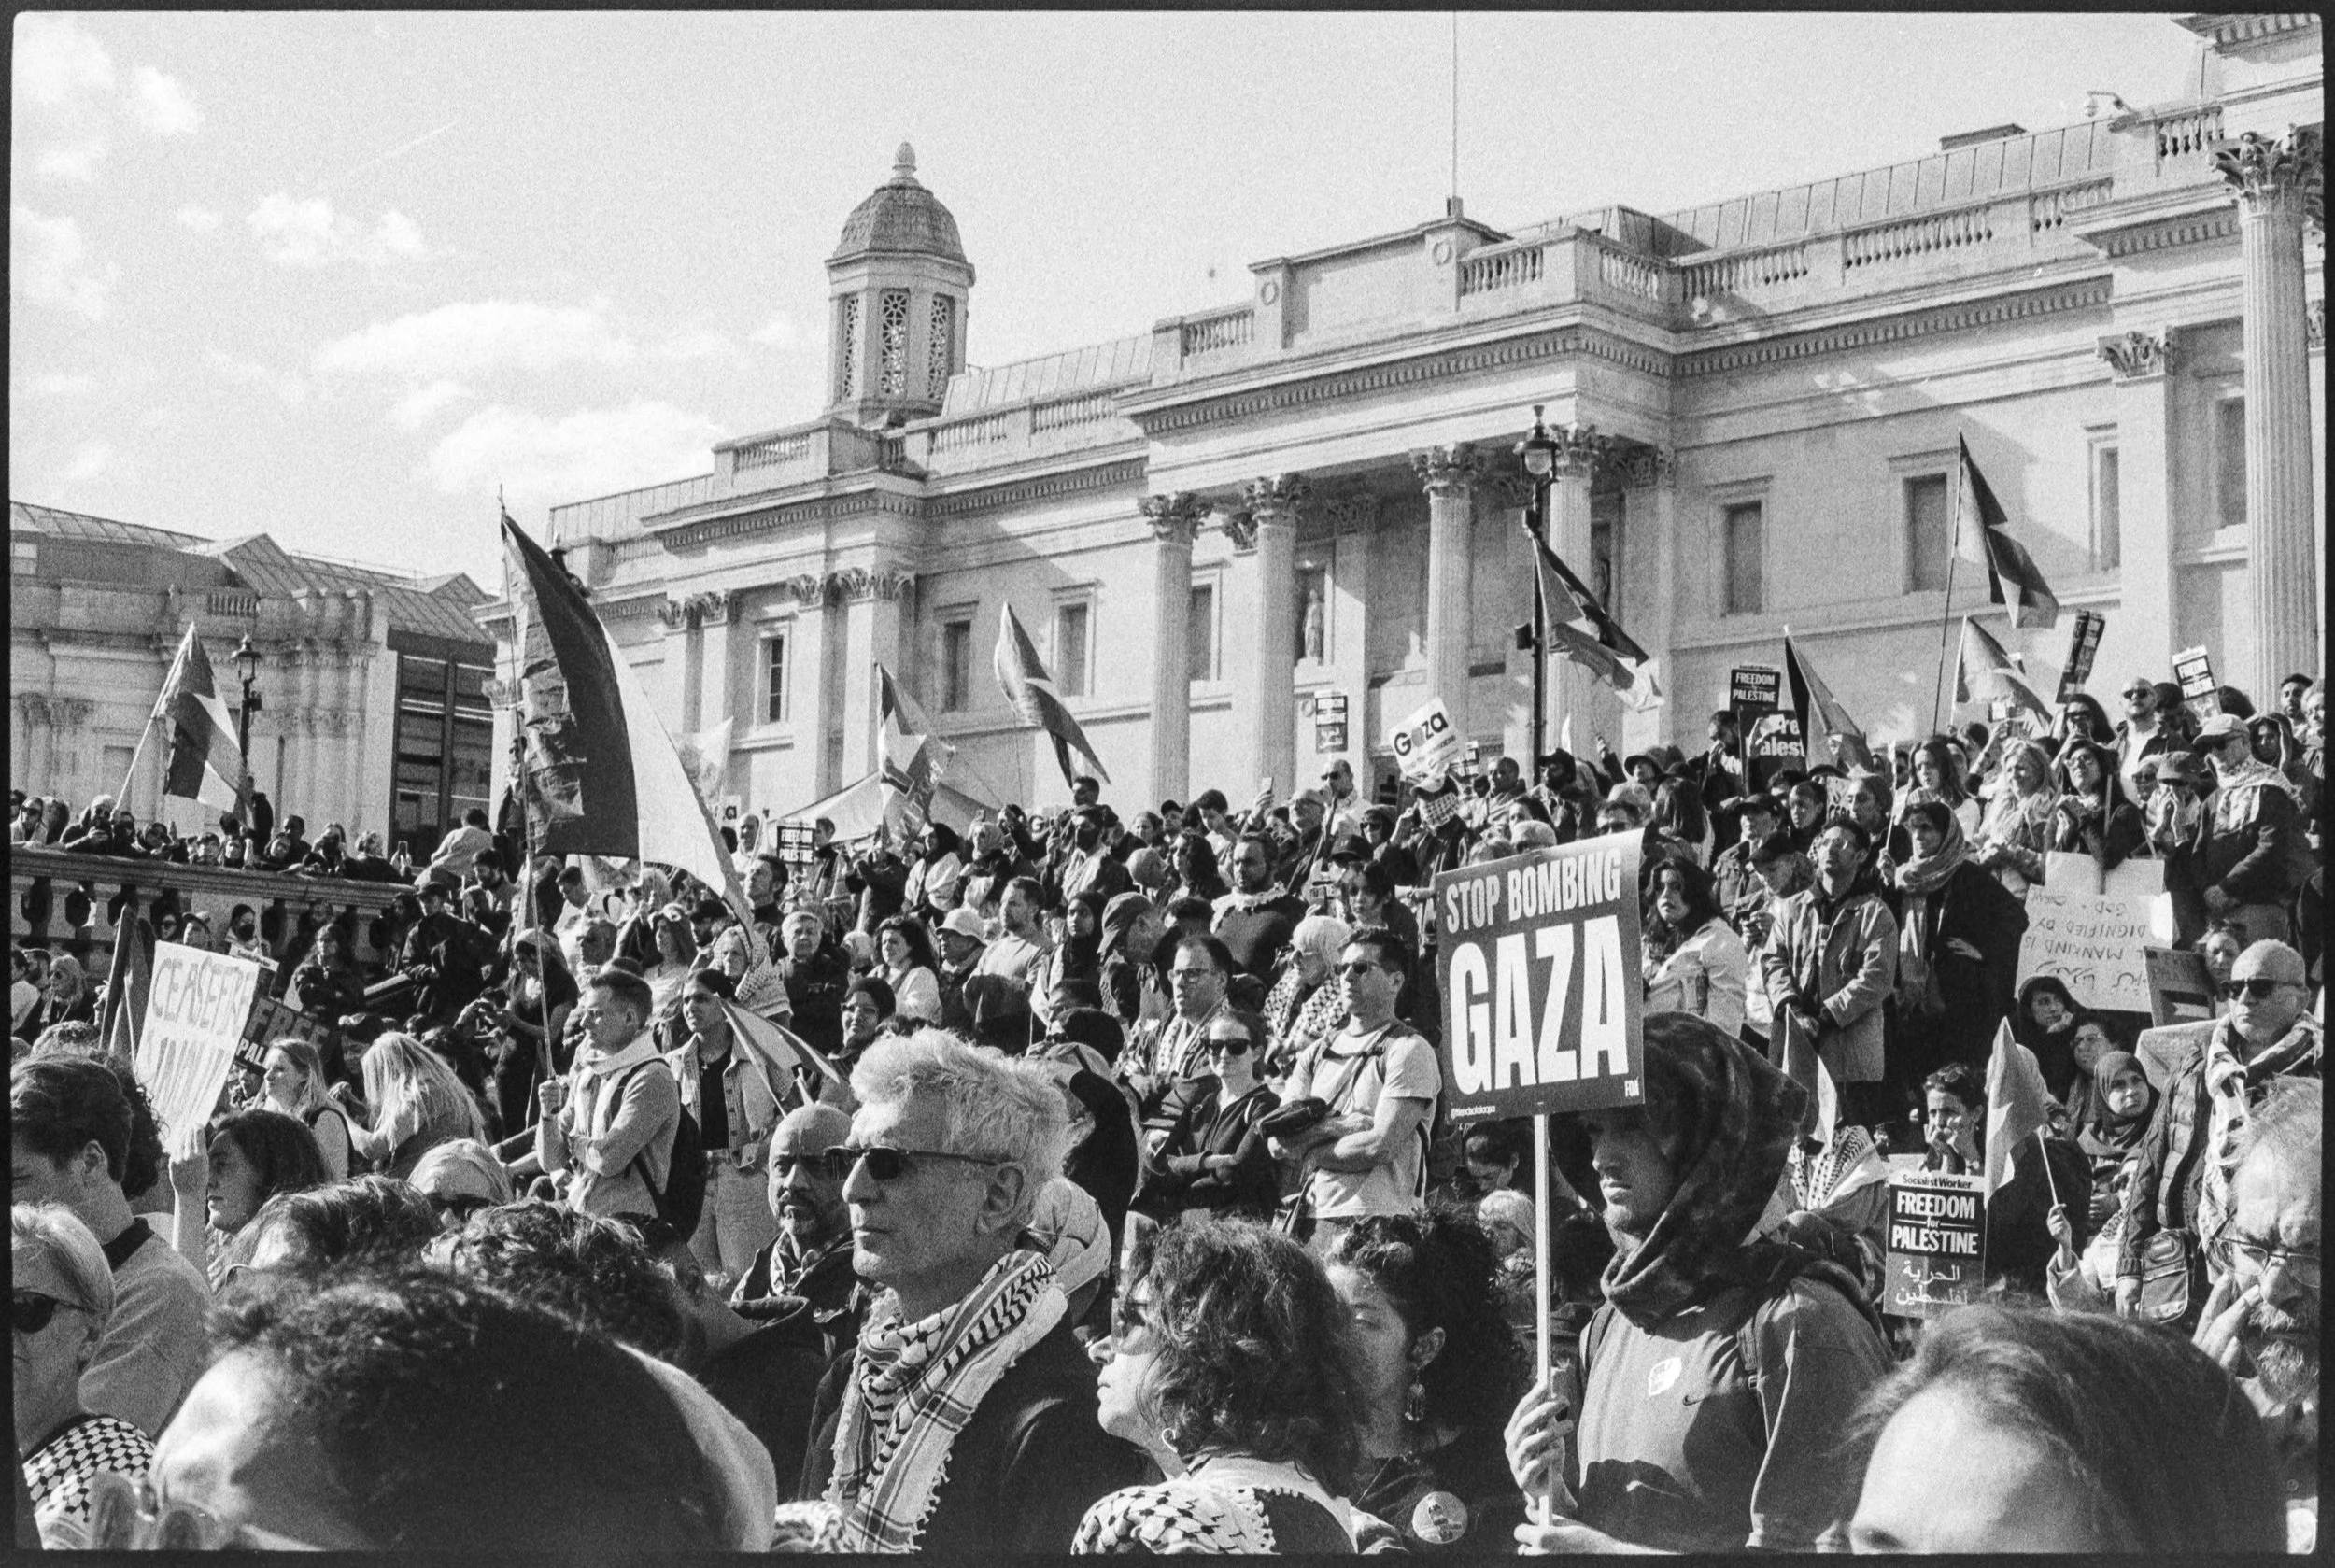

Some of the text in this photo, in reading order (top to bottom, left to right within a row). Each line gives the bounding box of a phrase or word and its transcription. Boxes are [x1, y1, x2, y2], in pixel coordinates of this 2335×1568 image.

[1735, 672, 1775, 685] FREEDOM
[1733, 689, 1776, 702] PALESTINE
[1446, 847, 1621, 933] STOP BOMBING
[2066, 921, 2146, 938] DIGNIFIED
[1449, 914, 1629, 1095] GAZA
[1938, 1178, 1973, 1190] Worker
[1896, 1190, 1975, 1220] FREEDOM
[1926, 1217, 1941, 1228] for
[1891, 1224, 1979, 1255] PALESTINE
[1903, 1260, 1960, 1286] الحرية
